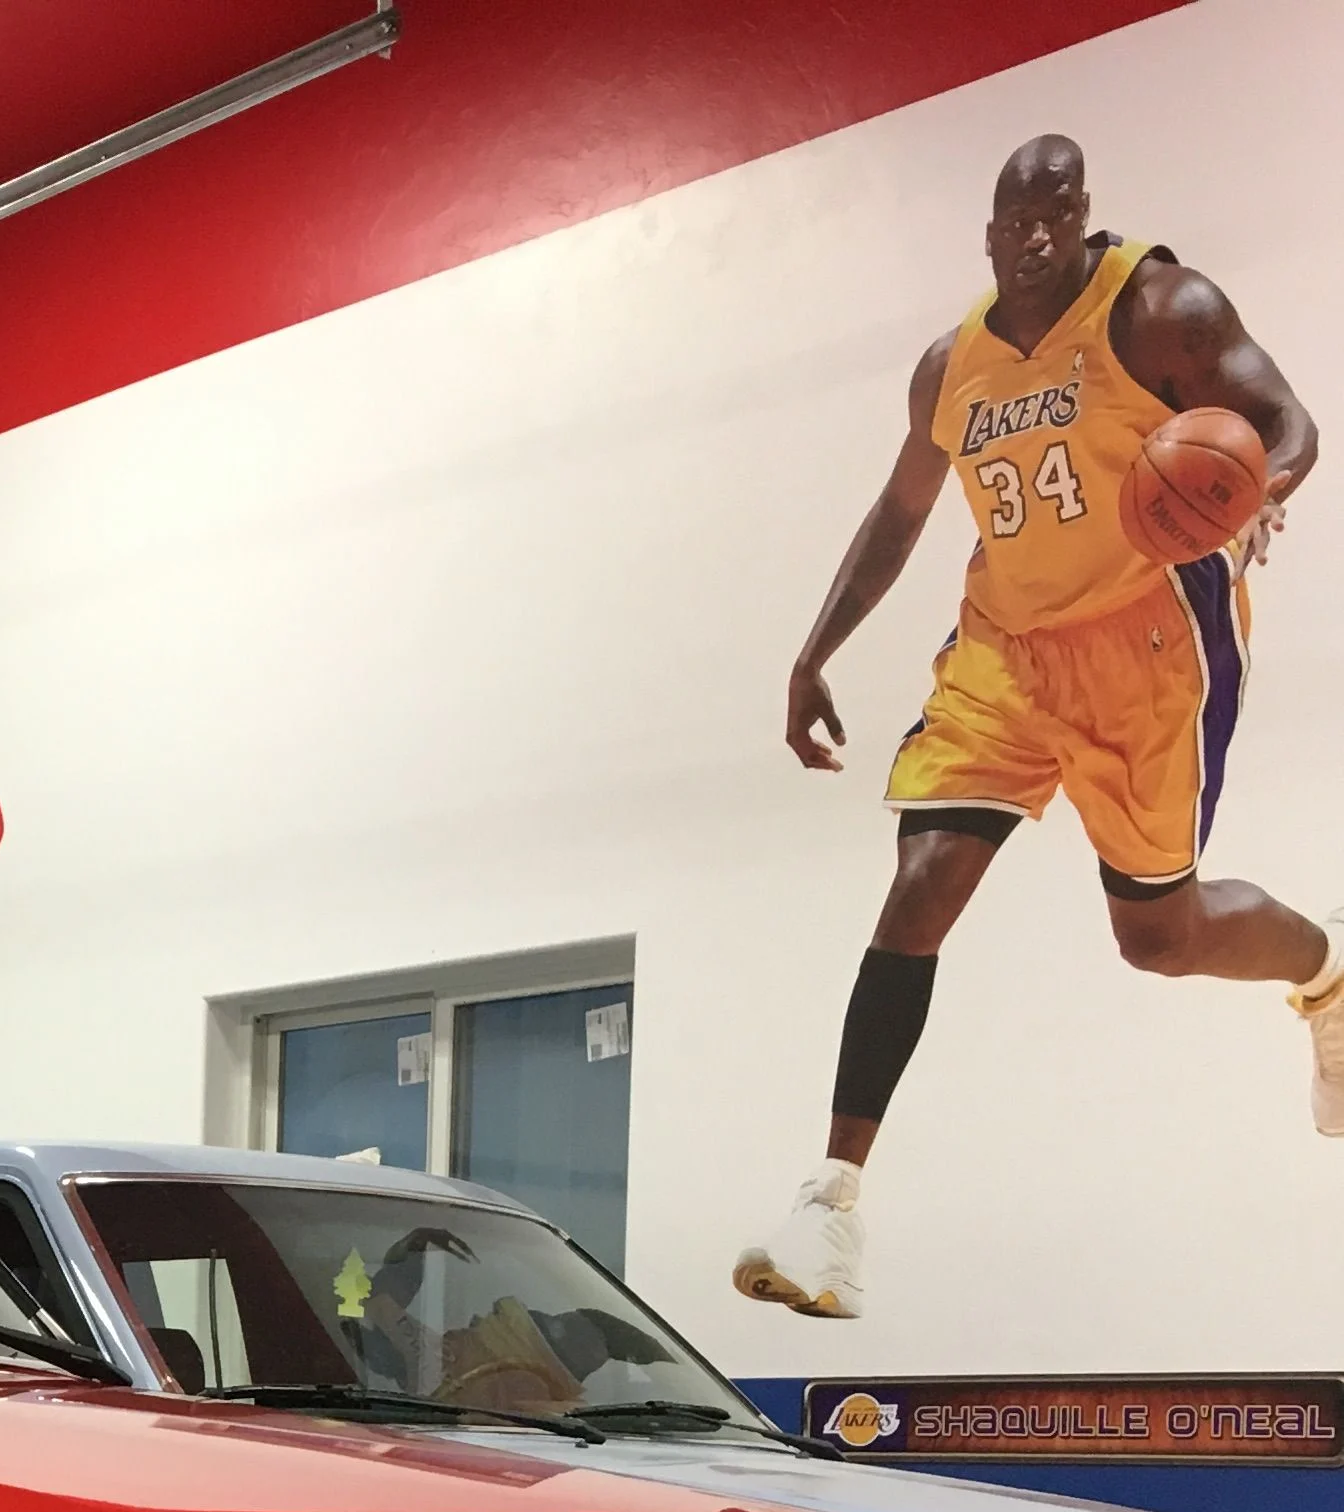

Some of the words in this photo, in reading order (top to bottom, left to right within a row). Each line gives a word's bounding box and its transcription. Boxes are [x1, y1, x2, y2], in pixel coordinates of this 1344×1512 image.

[958, 381, 1081, 457] LAKERS
[975, 441, 1087, 538] 34
[826, 1404, 896, 1434] LAKERS
[914, 1403, 1149, 1440] SHAQUILLE
[1166, 1403, 1336, 1439] O'NEAL
